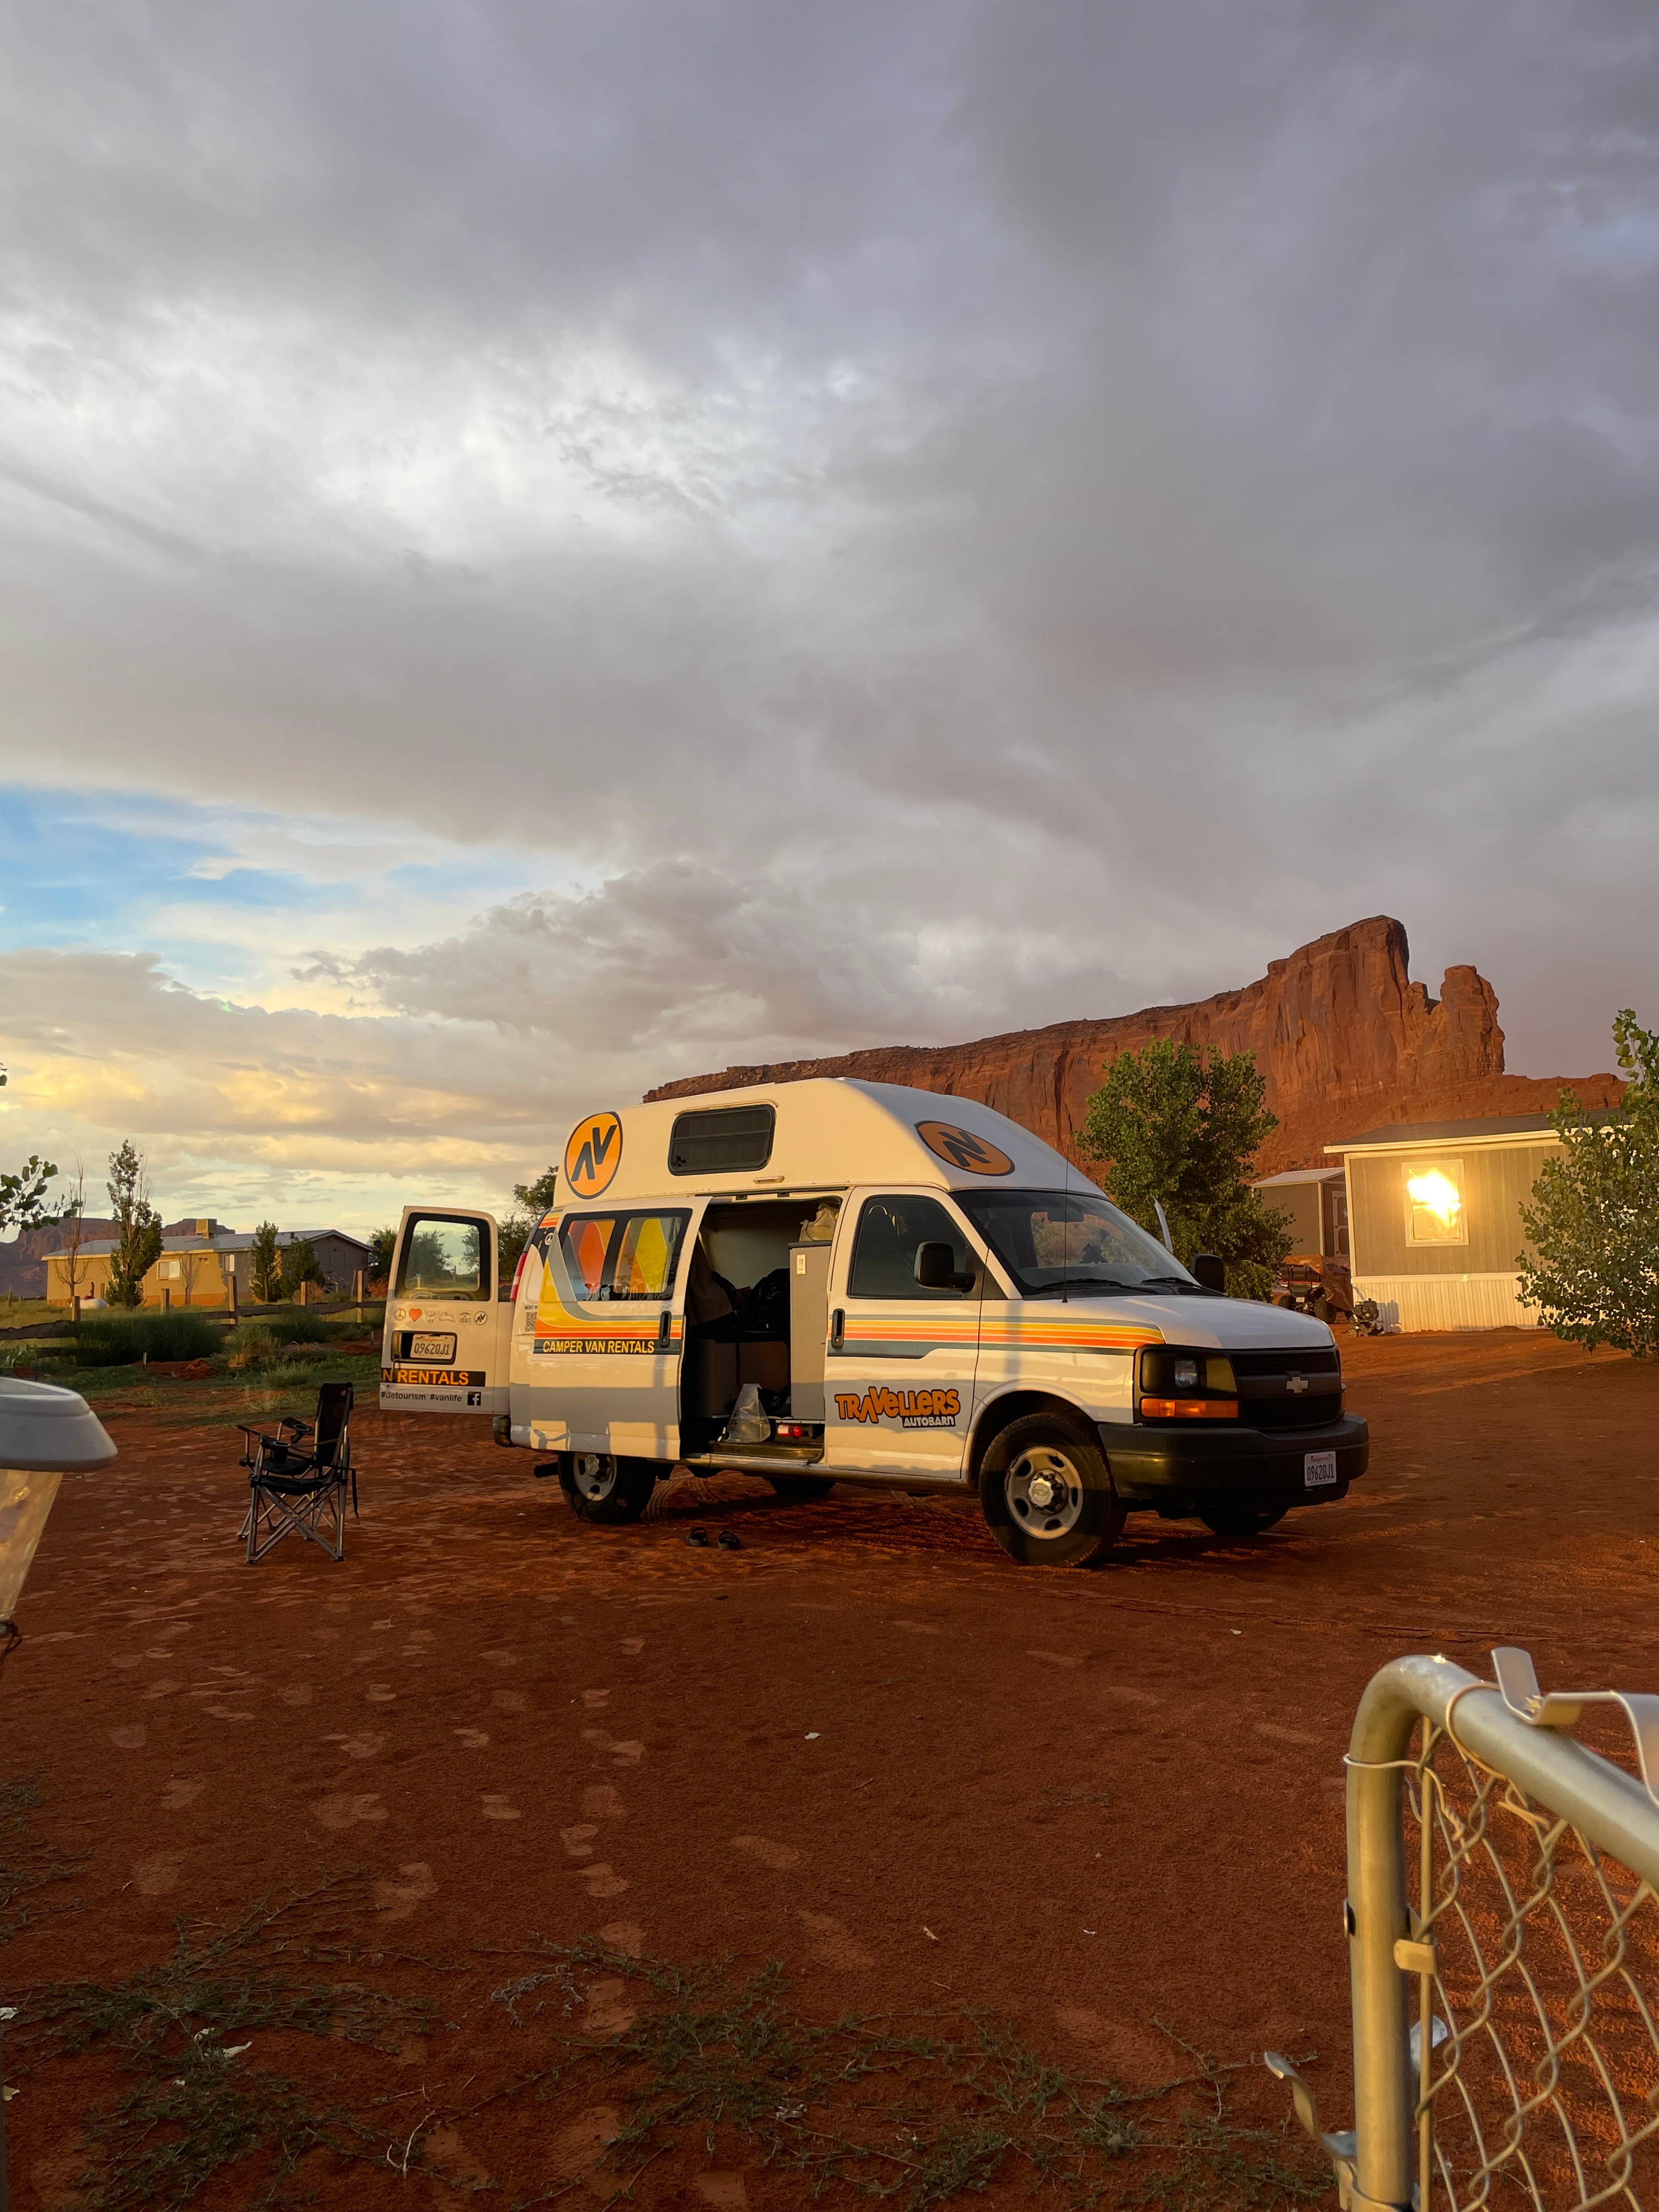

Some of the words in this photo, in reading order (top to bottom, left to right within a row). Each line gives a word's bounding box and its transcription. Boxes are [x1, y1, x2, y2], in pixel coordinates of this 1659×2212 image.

[414, 1343, 450, 1356] 09620J1
[543, 1340, 583, 1353] CAMPER
[585, 1340, 606, 1353] VAN
[607, 1340, 655, 1353] RENTALS
[397, 1369, 469, 1386] RENTALS
[381, 1391, 426, 1400] #detourism
[430, 1393, 462, 1402] #vanlife
[1307, 1463, 1335, 1481] 09620J1
